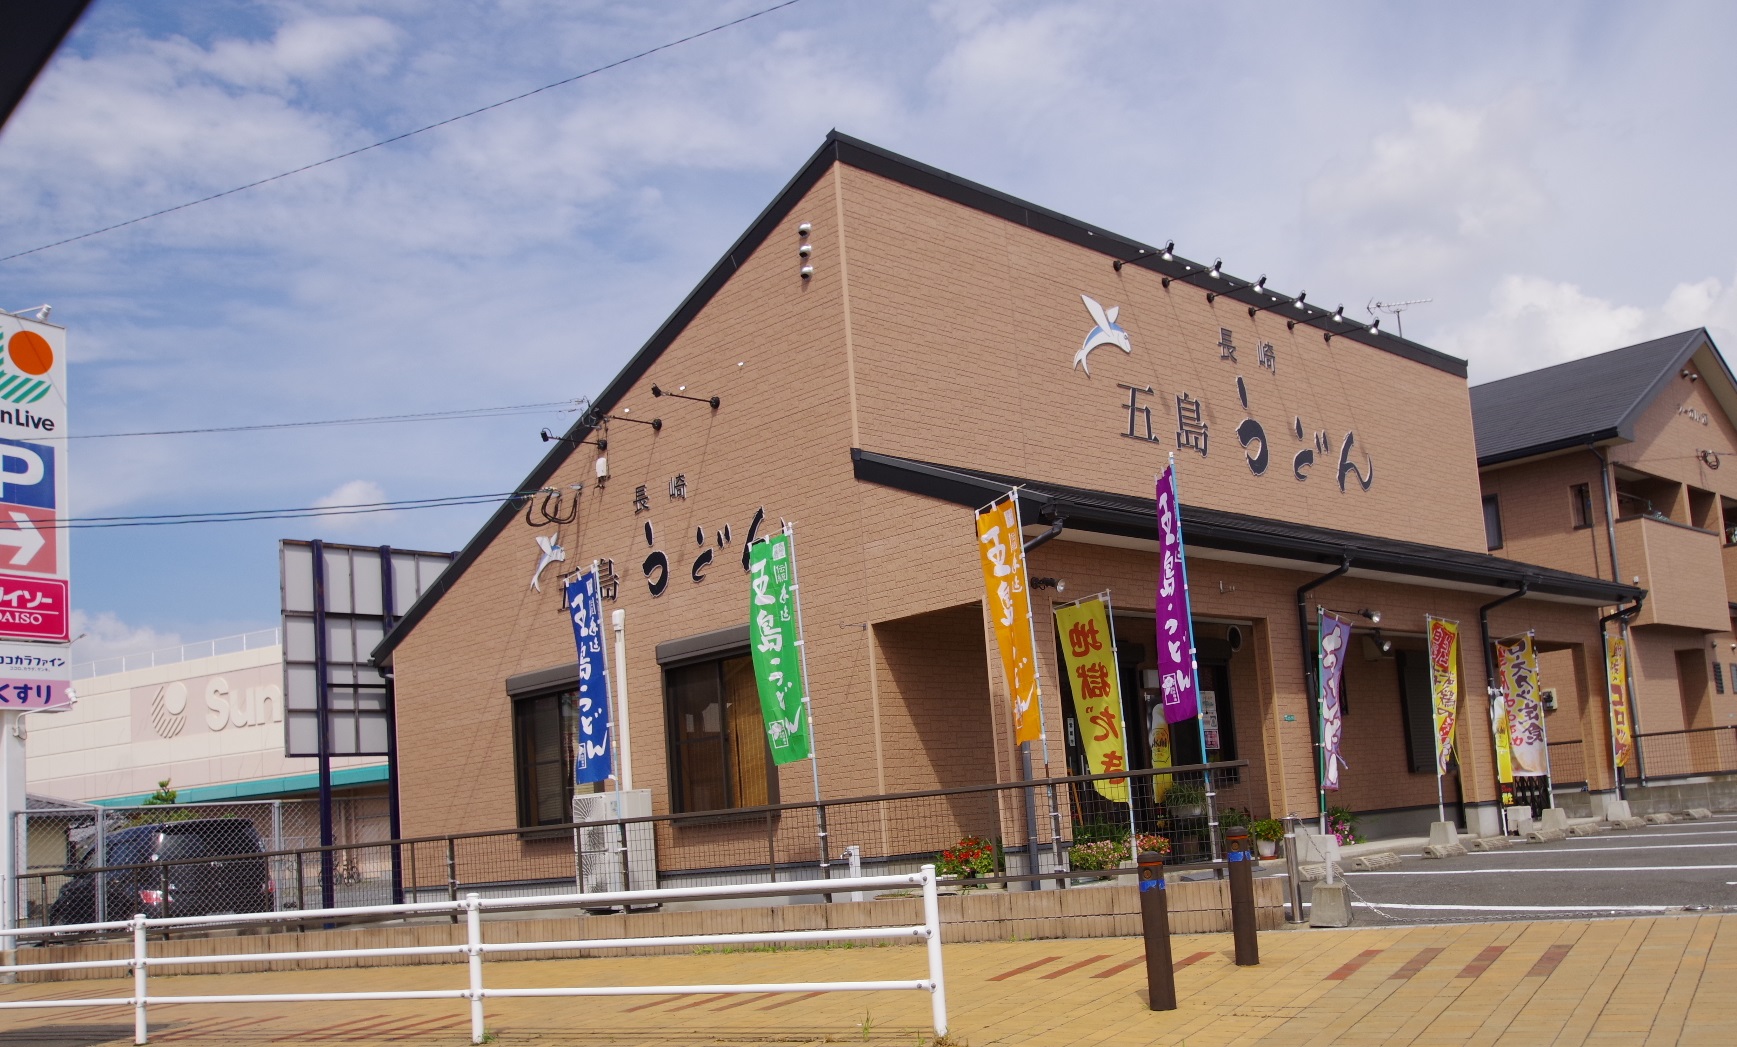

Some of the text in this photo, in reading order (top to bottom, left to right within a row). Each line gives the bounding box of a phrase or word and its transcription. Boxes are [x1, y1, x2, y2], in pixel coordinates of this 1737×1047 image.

[1218, 327, 1276, 375] 長崎
[633, 473, 687, 515] 長崎
[751, 558, 801, 737] 五島うどん
[0, 683, 52, 704] くすり
[205, 677, 283, 732] Sun
